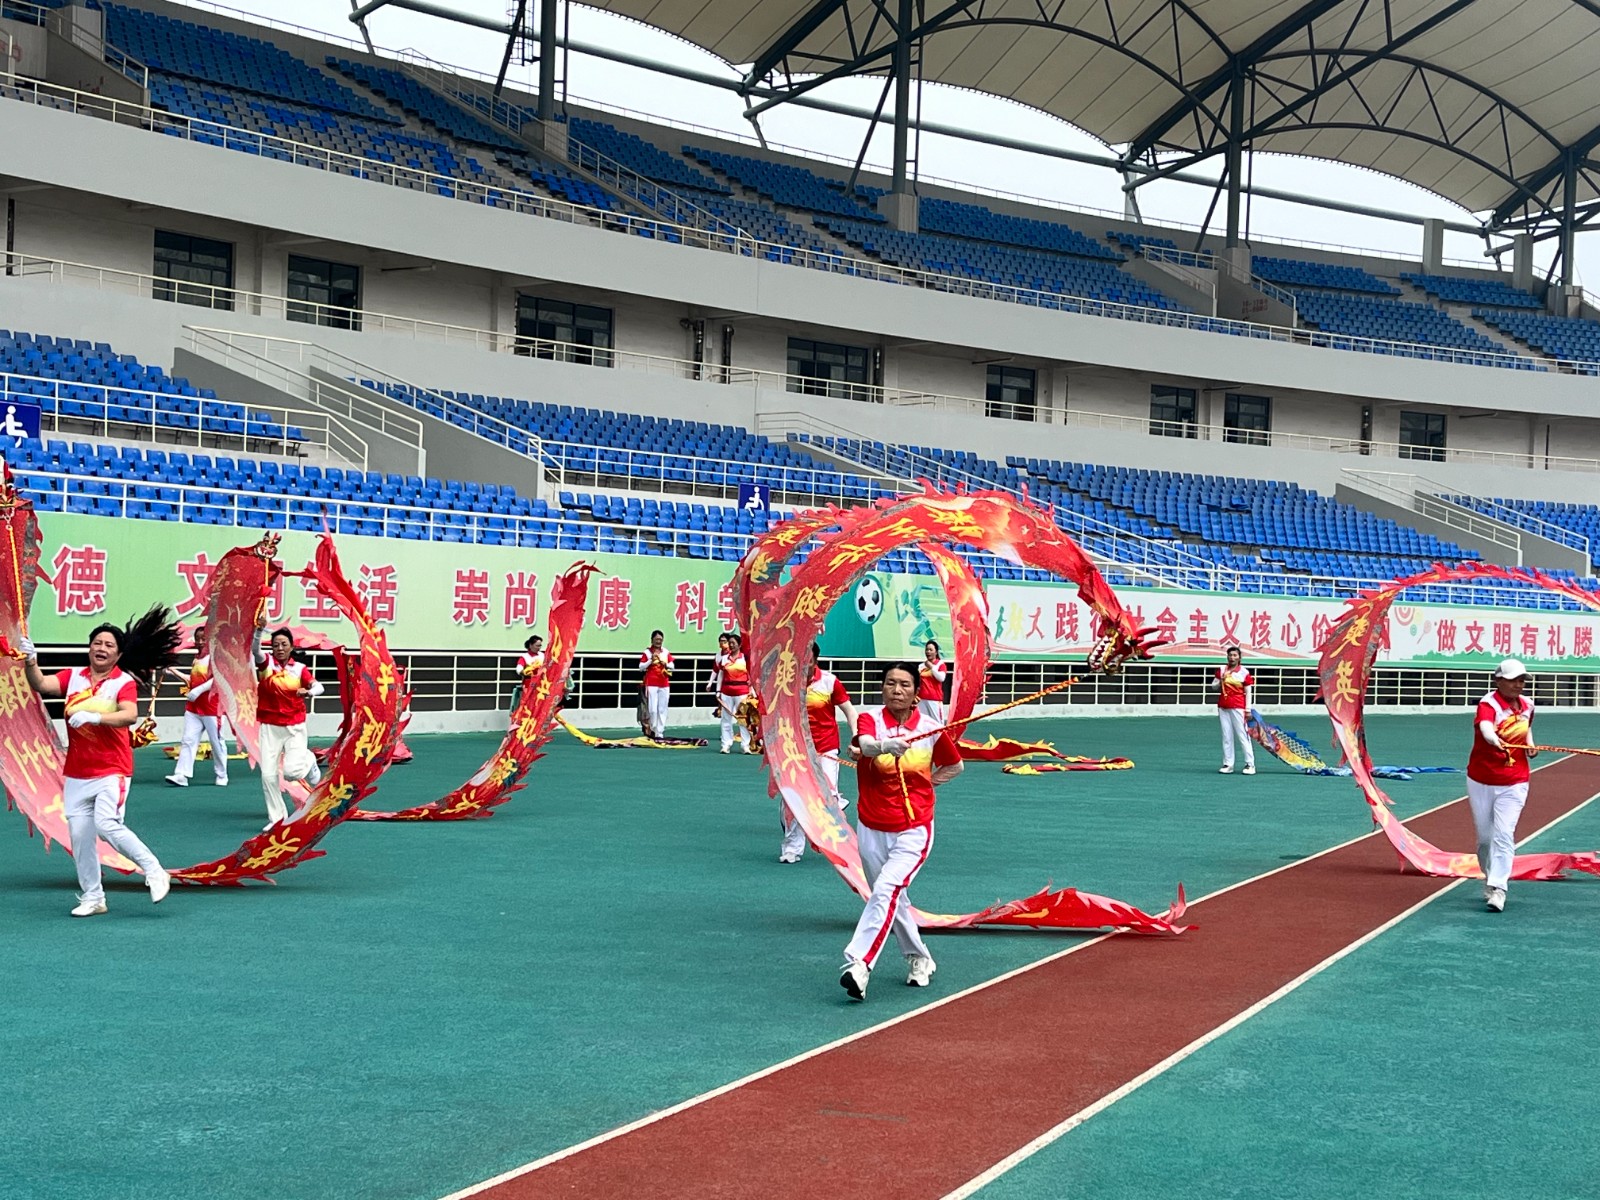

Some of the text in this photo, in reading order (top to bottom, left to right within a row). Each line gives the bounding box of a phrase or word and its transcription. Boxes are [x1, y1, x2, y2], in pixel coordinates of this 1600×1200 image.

[53, 547, 105, 612] 德
[176, 553, 397, 621] 文生活
[453, 569, 630, 628] 崇尚康
[1056, 602, 1592, 656] 践会主义核心价 做文明有礼滕
